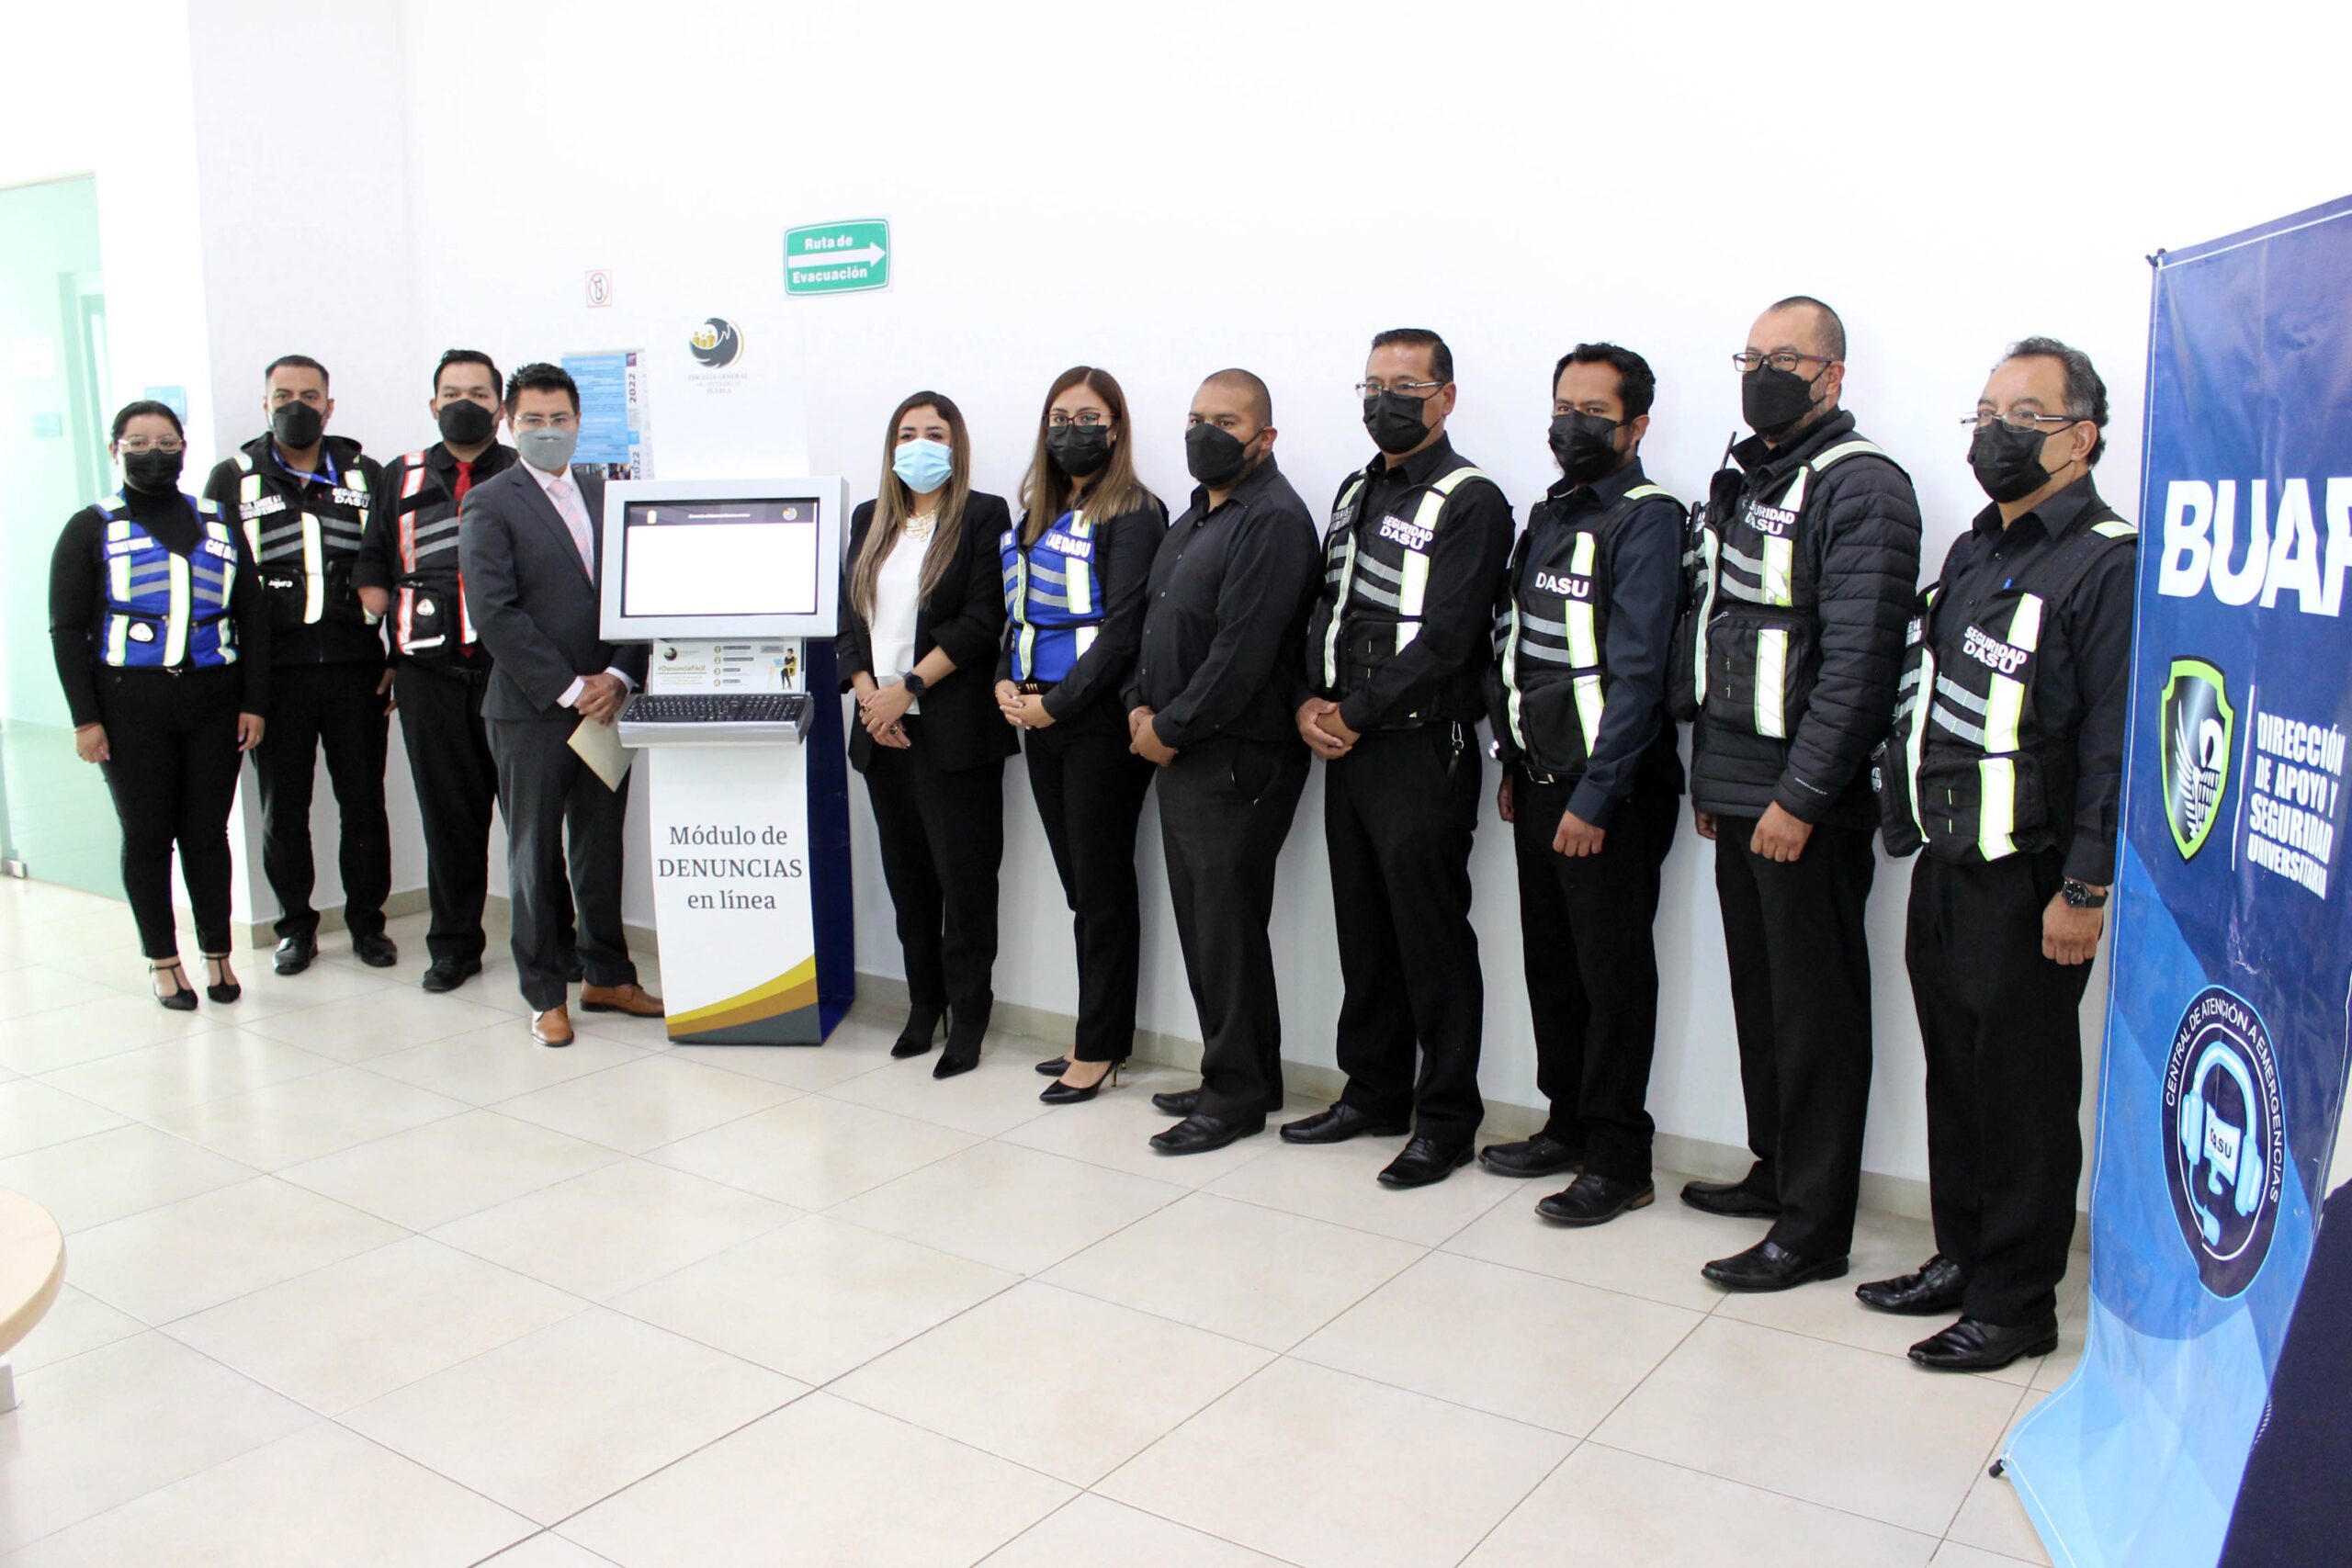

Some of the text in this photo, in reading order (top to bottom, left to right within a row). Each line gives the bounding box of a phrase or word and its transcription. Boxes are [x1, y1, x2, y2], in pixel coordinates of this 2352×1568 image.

[805, 234, 854, 251] Ruta de
[792, 265, 868, 284] Evacuación
[628, 373, 638, 404] 2022
[334, 496, 369, 508] DASU
[1748, 500, 1795, 525] SURIDAD
[1379, 525, 1425, 550] DASU
[1382, 515, 1433, 542] SEGURIDAD
[1060, 537, 1091, 557] DASU
[1534, 572, 1589, 597] DASU
[1962, 639, 2018, 674] DASU
[1963, 626, 2028, 665] SEGURIDAD
[2256, 711, 2346, 776] DIRECCIÓN
[2254, 755, 2339, 818] DE APOYO Y
[669, 825, 788, 846] Módulo de
[2249, 793, 2334, 865] SEGURIDAD
[658, 858, 803, 878] DENUNCIAS
[2246, 832, 2327, 900] UNIVERSITARIA
[687, 889, 777, 909] en línea
[2165, 998, 2282, 1203] CENTRAL DE ATENCIÓN A EMERGENCIAS
